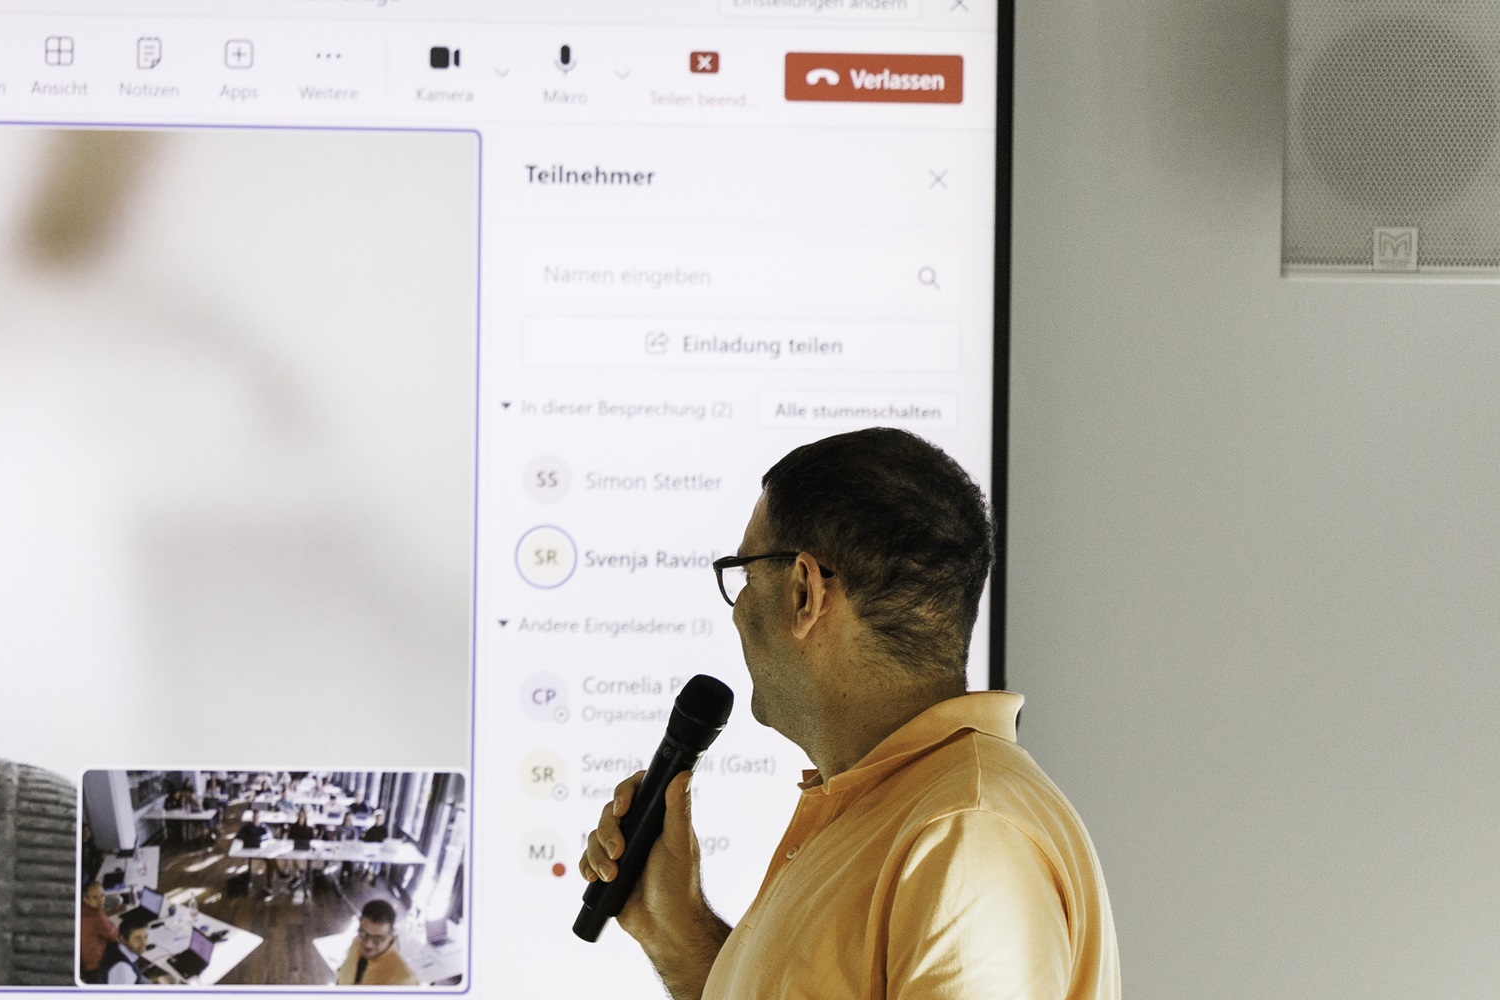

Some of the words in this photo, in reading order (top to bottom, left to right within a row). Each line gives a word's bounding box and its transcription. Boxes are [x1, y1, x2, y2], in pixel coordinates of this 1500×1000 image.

[30, 80, 88, 97] Ansicht
[849, 68, 946, 91] Verlassen
[118, 81, 180, 98] Notizen
[218, 83, 259, 103] Apps
[298, 85, 359, 101] Weitere
[415, 87, 475, 103] Kamera
[542, 89, 588, 104] Mikro
[525, 164, 656, 186] Teilnehmer
[543, 264, 615, 285] Namen
[619, 266, 713, 291] eingeben
[682, 334, 782, 360] Einladung
[788, 336, 844, 356] teilen
[520, 399, 537, 416] In
[541, 399, 593, 417] dieser
[597, 399, 707, 423] Besprechung
[709, 399, 734, 422] (2)
[774, 402, 807, 418] Alle
[812, 403, 942, 421] stummschalten
[536, 470, 559, 488] SS
[585, 471, 647, 491] Simon
[653, 471, 723, 493] Stettler
[534, 549, 558, 566] SR
[584, 549, 649, 574] Svenja
[518, 616, 580, 635] Andere
[584, 616, 687, 639] Eingeladene
[690, 617, 714, 638] (3)
[581, 675, 663, 697] Cornelia
[531, 688, 557, 706] CP
[531, 765, 555, 784] SR
[720, 754, 777, 776] (Gast)
[528, 844, 556, 861] MJ
